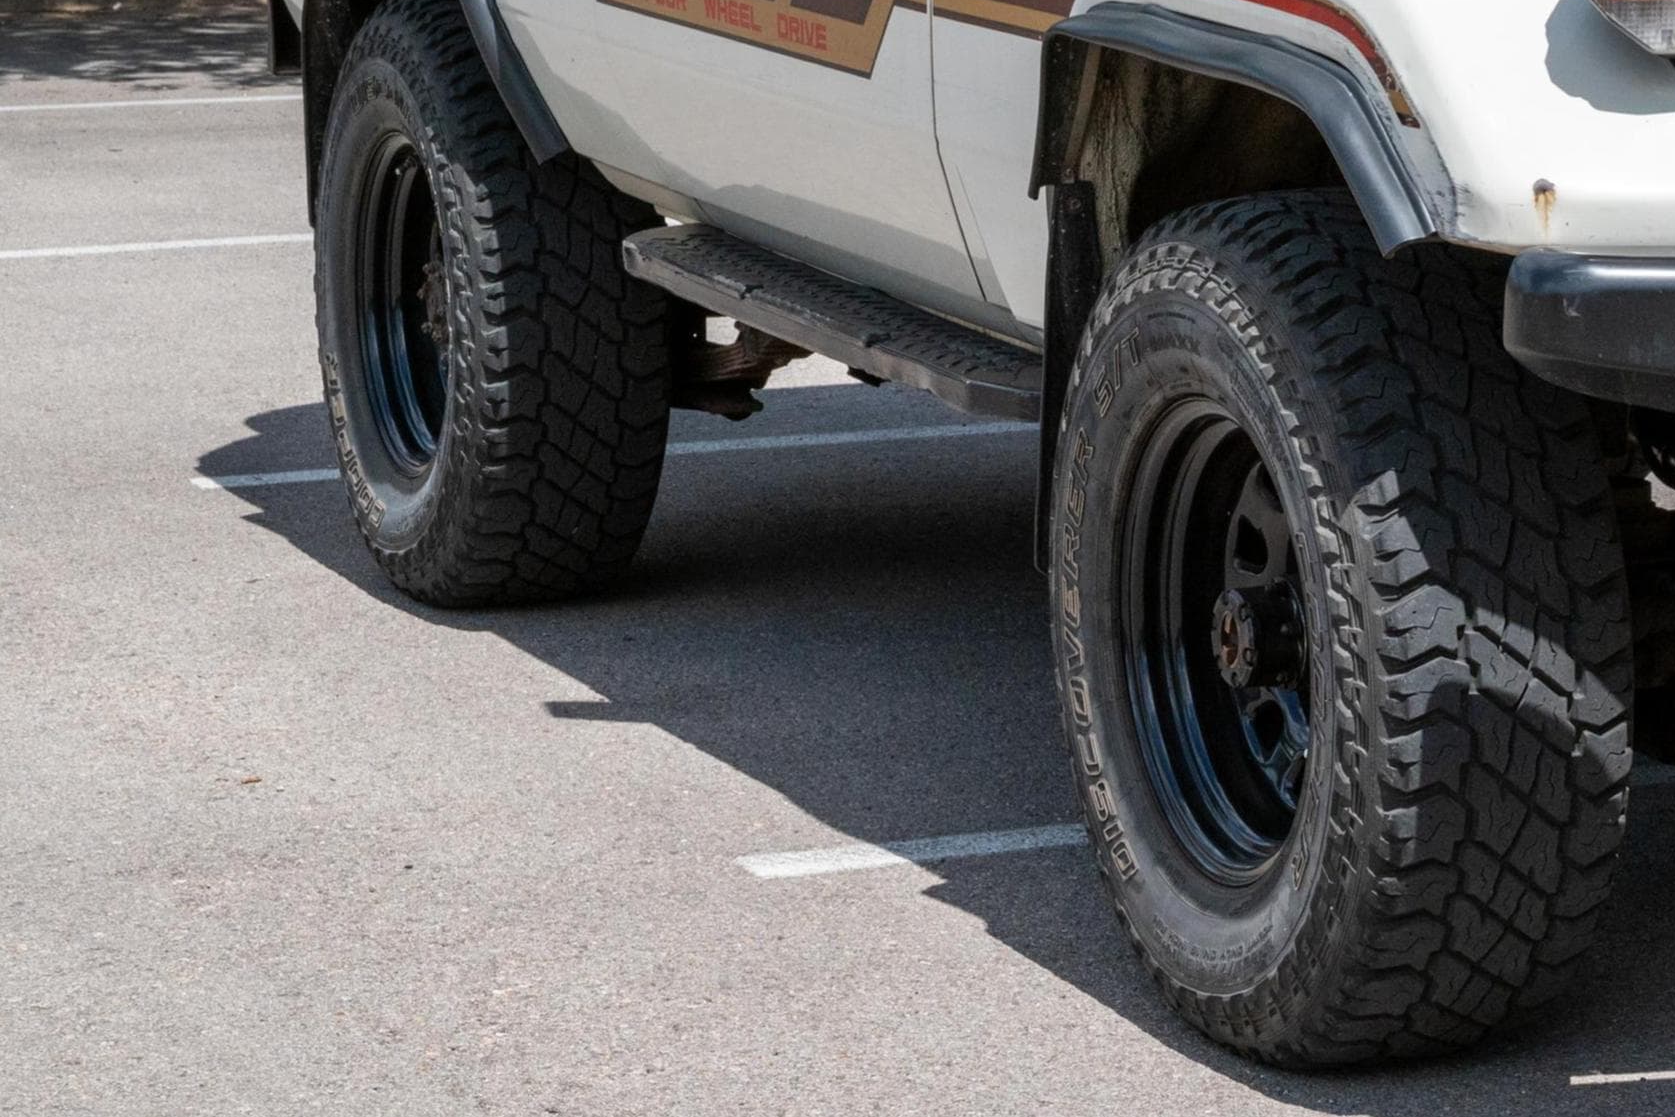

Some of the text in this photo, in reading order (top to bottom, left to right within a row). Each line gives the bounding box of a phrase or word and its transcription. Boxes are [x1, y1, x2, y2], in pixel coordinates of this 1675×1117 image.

[776, 12, 829, 52] DRIVE
[1093, 326, 1141, 419] S/T
[1061, 426, 1139, 882] DISCOVERER
